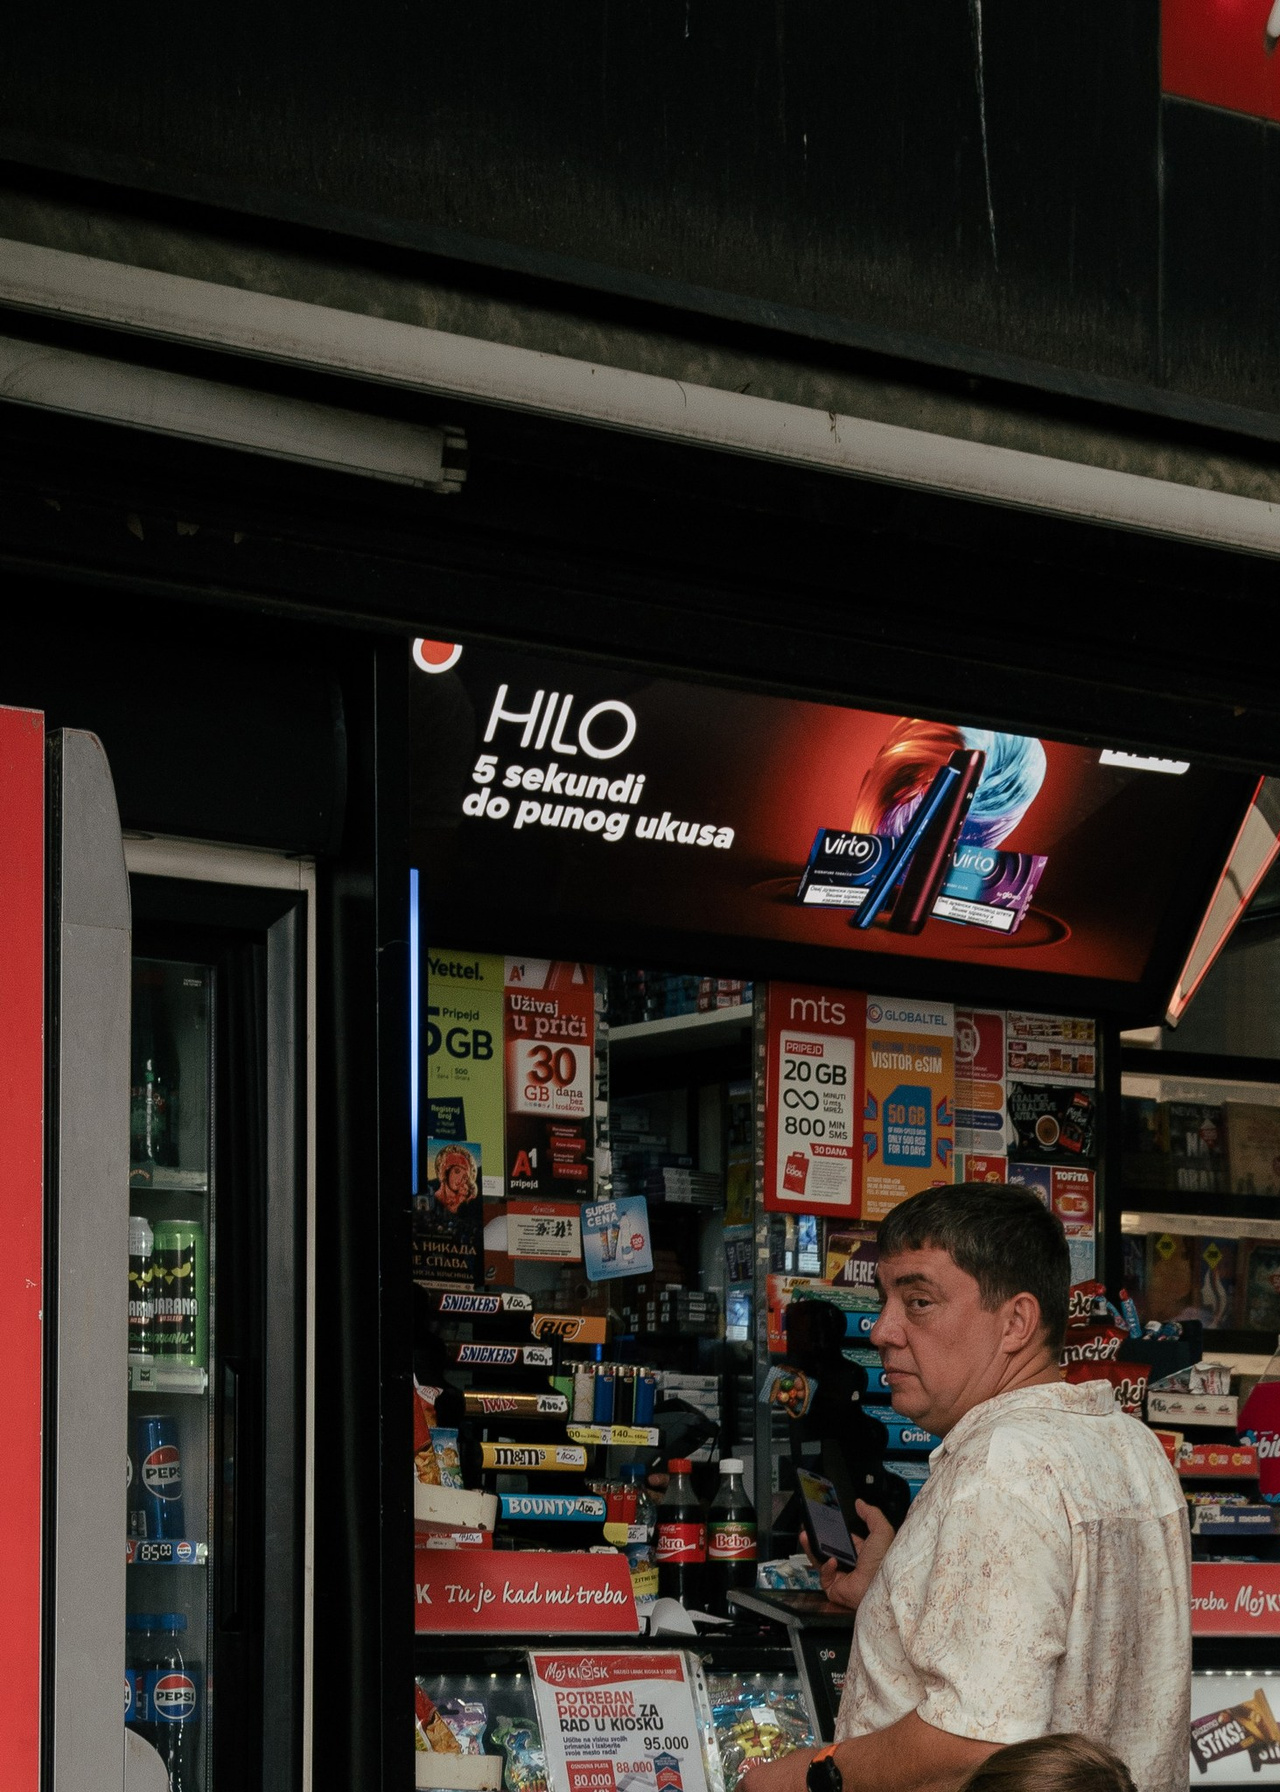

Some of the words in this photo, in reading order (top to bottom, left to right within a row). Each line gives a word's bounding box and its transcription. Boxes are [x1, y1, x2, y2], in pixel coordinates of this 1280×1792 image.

[483, 683, 637, 760] HILO
[472, 754, 498, 784] 5
[502, 763, 646, 804] sekundi
[462, 787, 510, 819] do
[513, 800, 630, 842] punog
[635, 811, 735, 849] ukusa
[825, 834, 870, 858] virto
[953, 849, 995, 873] virto
[442, 1007, 480, 1021] Pripejd
[511, 994, 559, 1017] Uživaj
[790, 996, 846, 1026] mts
[884, 1009, 948, 1026] GLOBALTEL
[513, 1014, 528, 1032] u
[535, 1015, 588, 1039] priči
[446, 1027, 494, 1060] GB
[785, 1041, 823, 1056] PRIPEJD
[526, 1045, 577, 1088] 30
[871, 1051, 912, 1071] VISITOR
[915, 1055, 943, 1074] eSIM
[784, 1059, 811, 1082] 20
[815, 1064, 847, 1086] GB
[524, 1085, 550, 1102] GB
[556, 1087, 583, 1099] dana
[570, 1097, 583, 1105] bez
[823, 1091, 846, 1101] MINUTI
[784, 1116, 825, 1137] 800
[829, 1120, 845, 1130] MIN
[829, 1130, 848, 1140] SMS
[814, 1145, 824, 1155] 30
[825, 1146, 848, 1157] DANA
[510, 1179, 538, 1189] pripejd
[585, 1202, 617, 1218] SUPER
[587, 1213, 618, 1227] CENA
[441, 1293, 499, 1313] SNICKERS
[459, 1345, 517, 1364] SNICKERS
[901, 1428, 931, 1445] Orbit
[508, 1497, 576, 1516] BOUNTY
[715, 1532, 751, 1549] Bebo
[445, 1585, 475, 1603] Tu
[473, 1582, 496, 1613] je
[502, 1581, 542, 1604] kad
[545, 1584, 575, 1605] mi
[571, 1582, 628, 1605] treba
[1234, 1585, 1265, 1617] Moj
[820, 1649, 835, 1661] glo
[544, 1662, 567, 1682] Moj
[567, 1659, 609, 1680] KIOSK
[156, 1691, 194, 1701] PEPSI
[555, 1691, 634, 1705] POTREBAN
[557, 1704, 636, 1719] PRODAVAC
[639, 1704, 660, 1717] ZA
[560, 1718, 590, 1732] RAD
[595, 1718, 606, 1731] U
[611, 1717, 664, 1731] KIOSKU
[643, 1736, 689, 1750] 95.000
[616, 1761, 653, 1773] 88.000
[574, 1774, 612, 1786] 80.000
